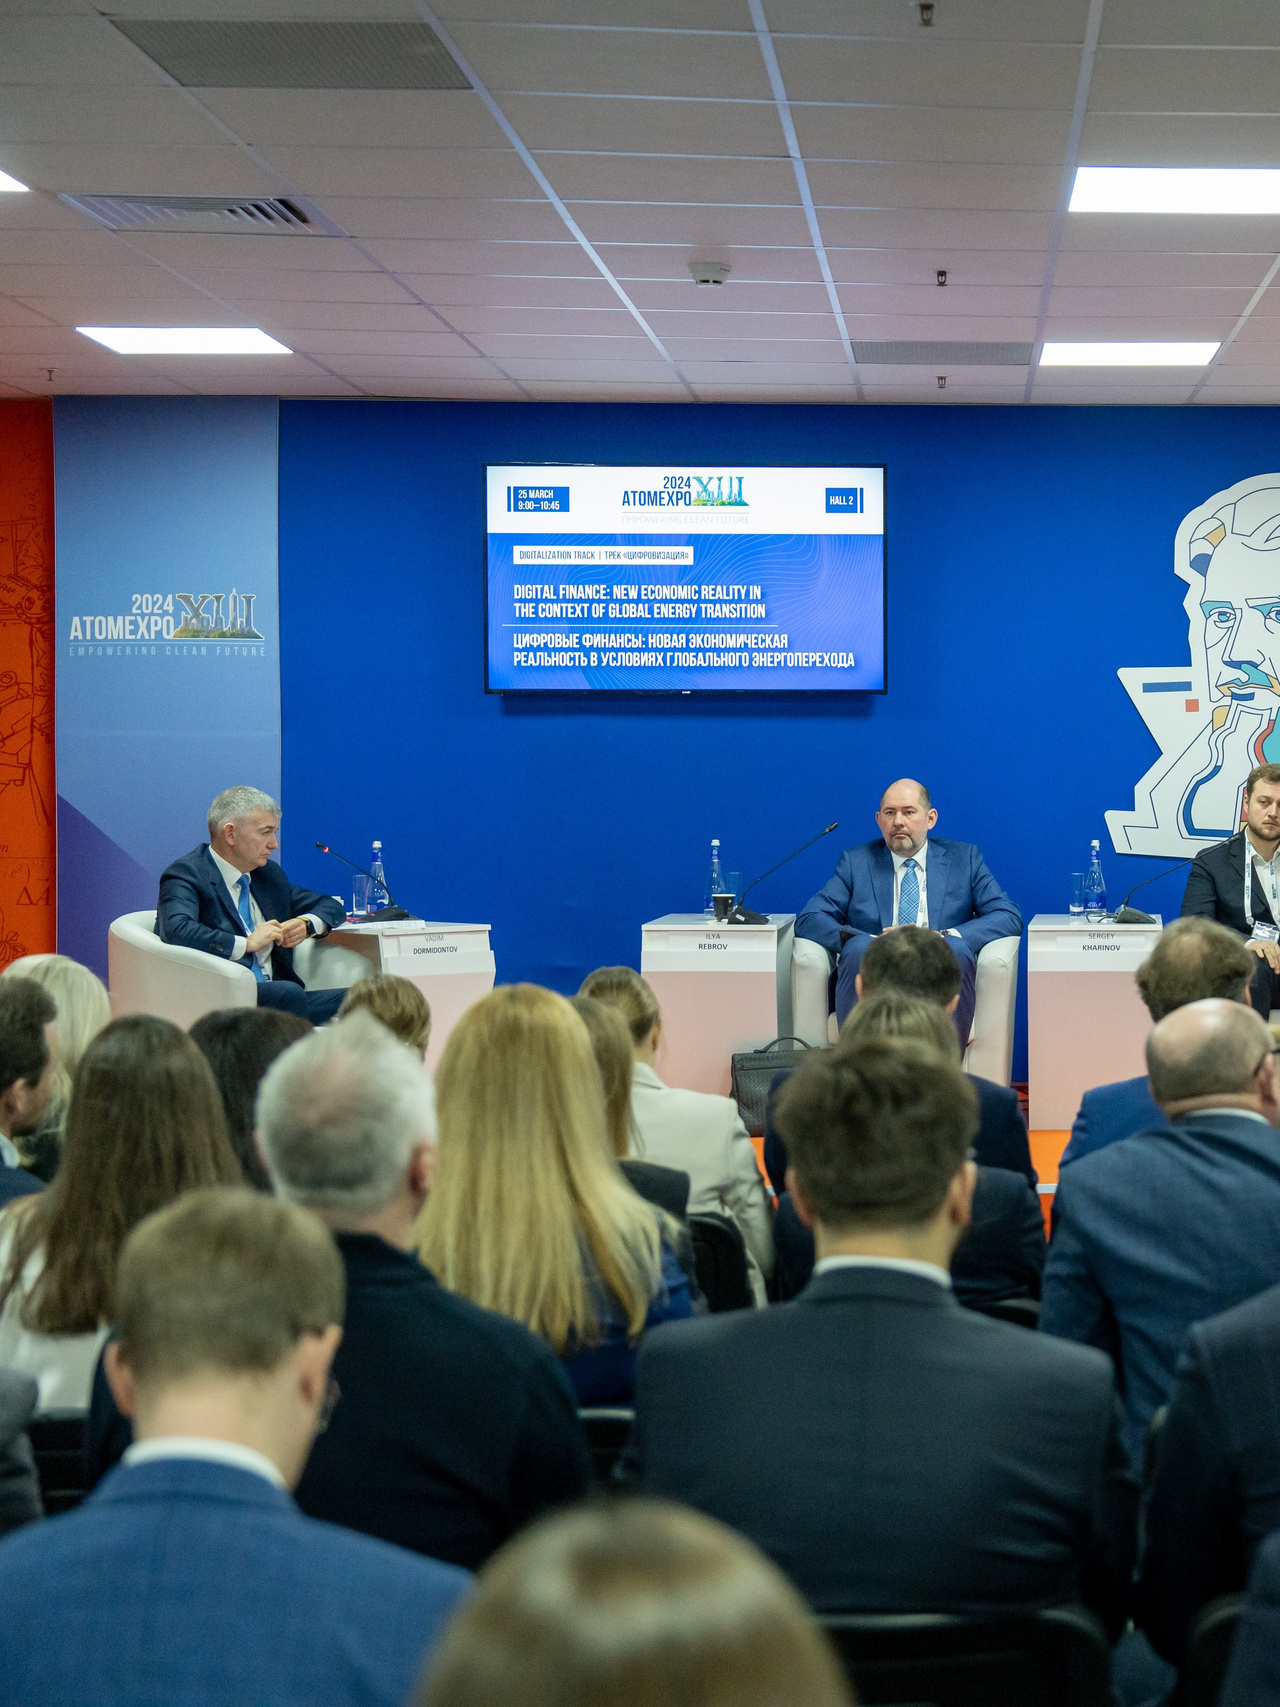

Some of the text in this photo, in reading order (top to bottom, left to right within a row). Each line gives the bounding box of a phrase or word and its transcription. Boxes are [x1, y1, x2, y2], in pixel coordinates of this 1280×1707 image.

[663, 476, 691, 489] 2024
[518, 489, 554, 499] 25 MARCH
[622, 490, 692, 506] ATOMEXPO
[829, 496, 854, 505] HALL 2
[622, 516, 749, 524] EMPOWERING CLEAN FUTURE
[519, 551, 595, 560] DIGITALIZATION TRACK
[605, 551, 689, 561] ТРЕК «ЦИФРОВИЗАЦИЯ»
[514, 584, 761, 600] DIGITAL FINANCE: NEW ECONOMIC REALITY IN
[132, 594, 174, 614] 2024
[514, 603, 766, 618] THE CONTEXT OF GLOBAL ENERGY TRANSITION
[70, 616, 174, 640] ATOMEXPO
[513, 633, 788, 649] ЦИФРОВЫЕ ФИНАНСЫ: НОВАЯ ЭКОНОМИЧЕСКАЯ
[70, 646, 265, 656] EMPOWERING CLEAN FUTURE
[513, 652, 855, 668] РЕАЛЬНОСТЬ В УСЛОВИЯХ ГЛОБАЛЬНОГО ЭНЕРГОПЕРЕХОДА
[413, 946, 458, 955] DORMIDONTOV
